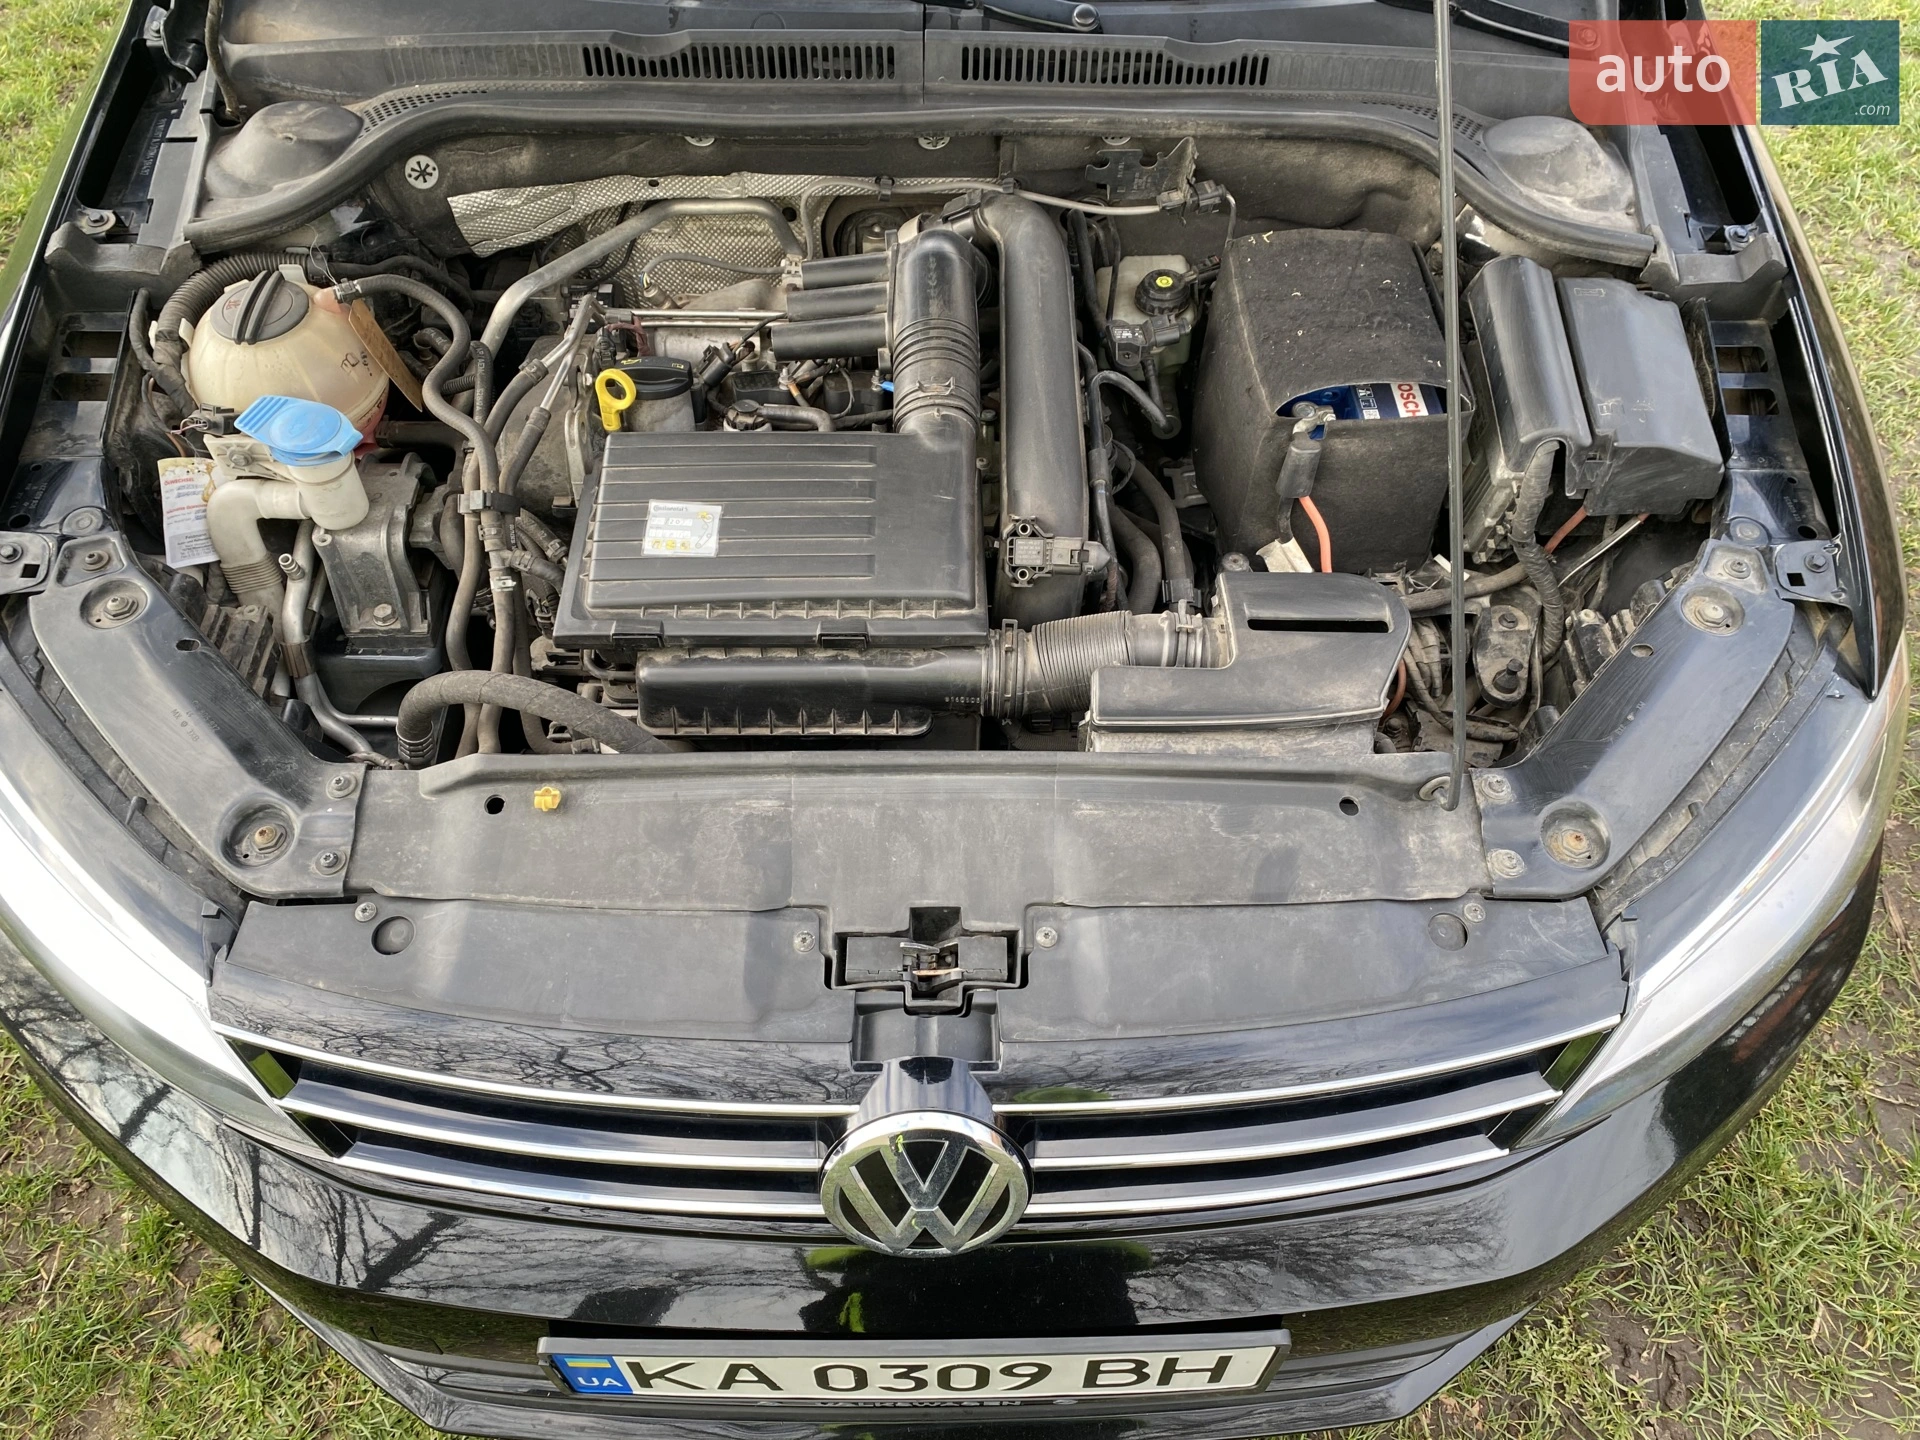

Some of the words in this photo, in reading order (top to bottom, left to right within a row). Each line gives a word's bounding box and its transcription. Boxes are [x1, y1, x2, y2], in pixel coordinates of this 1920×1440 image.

[1397, 383, 1421, 418] OSCH
[577, 1376, 624, 1387] UA
[625, 1361, 784, 1391] KA
[813, 1361, 1053, 1393] 0309
[1081, 1355, 1234, 1389] BH
